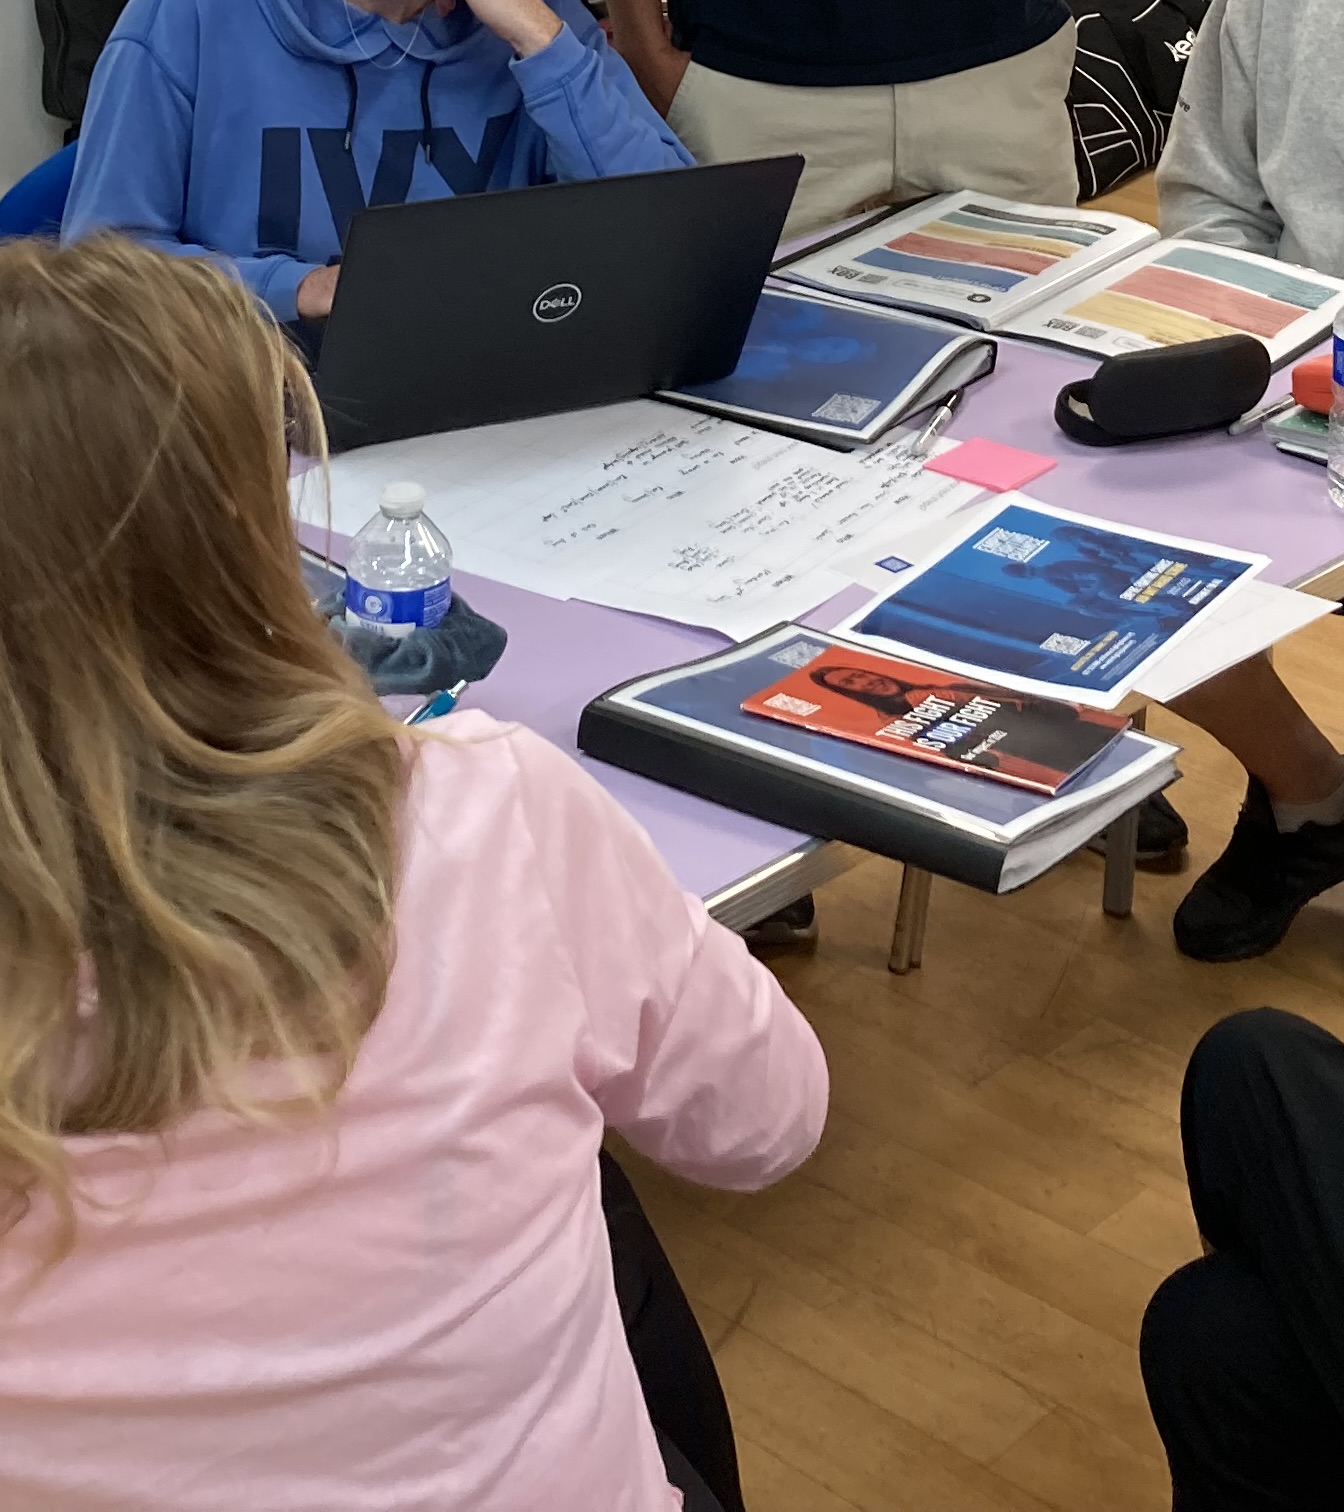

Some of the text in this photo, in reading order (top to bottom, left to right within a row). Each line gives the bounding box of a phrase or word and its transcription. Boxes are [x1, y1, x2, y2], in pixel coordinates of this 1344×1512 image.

[539, 296, 576, 312] DELL
[875, 694, 955, 741] THIS FIGHT
[912, 696, 1001, 752] IS OUR FIGHT
